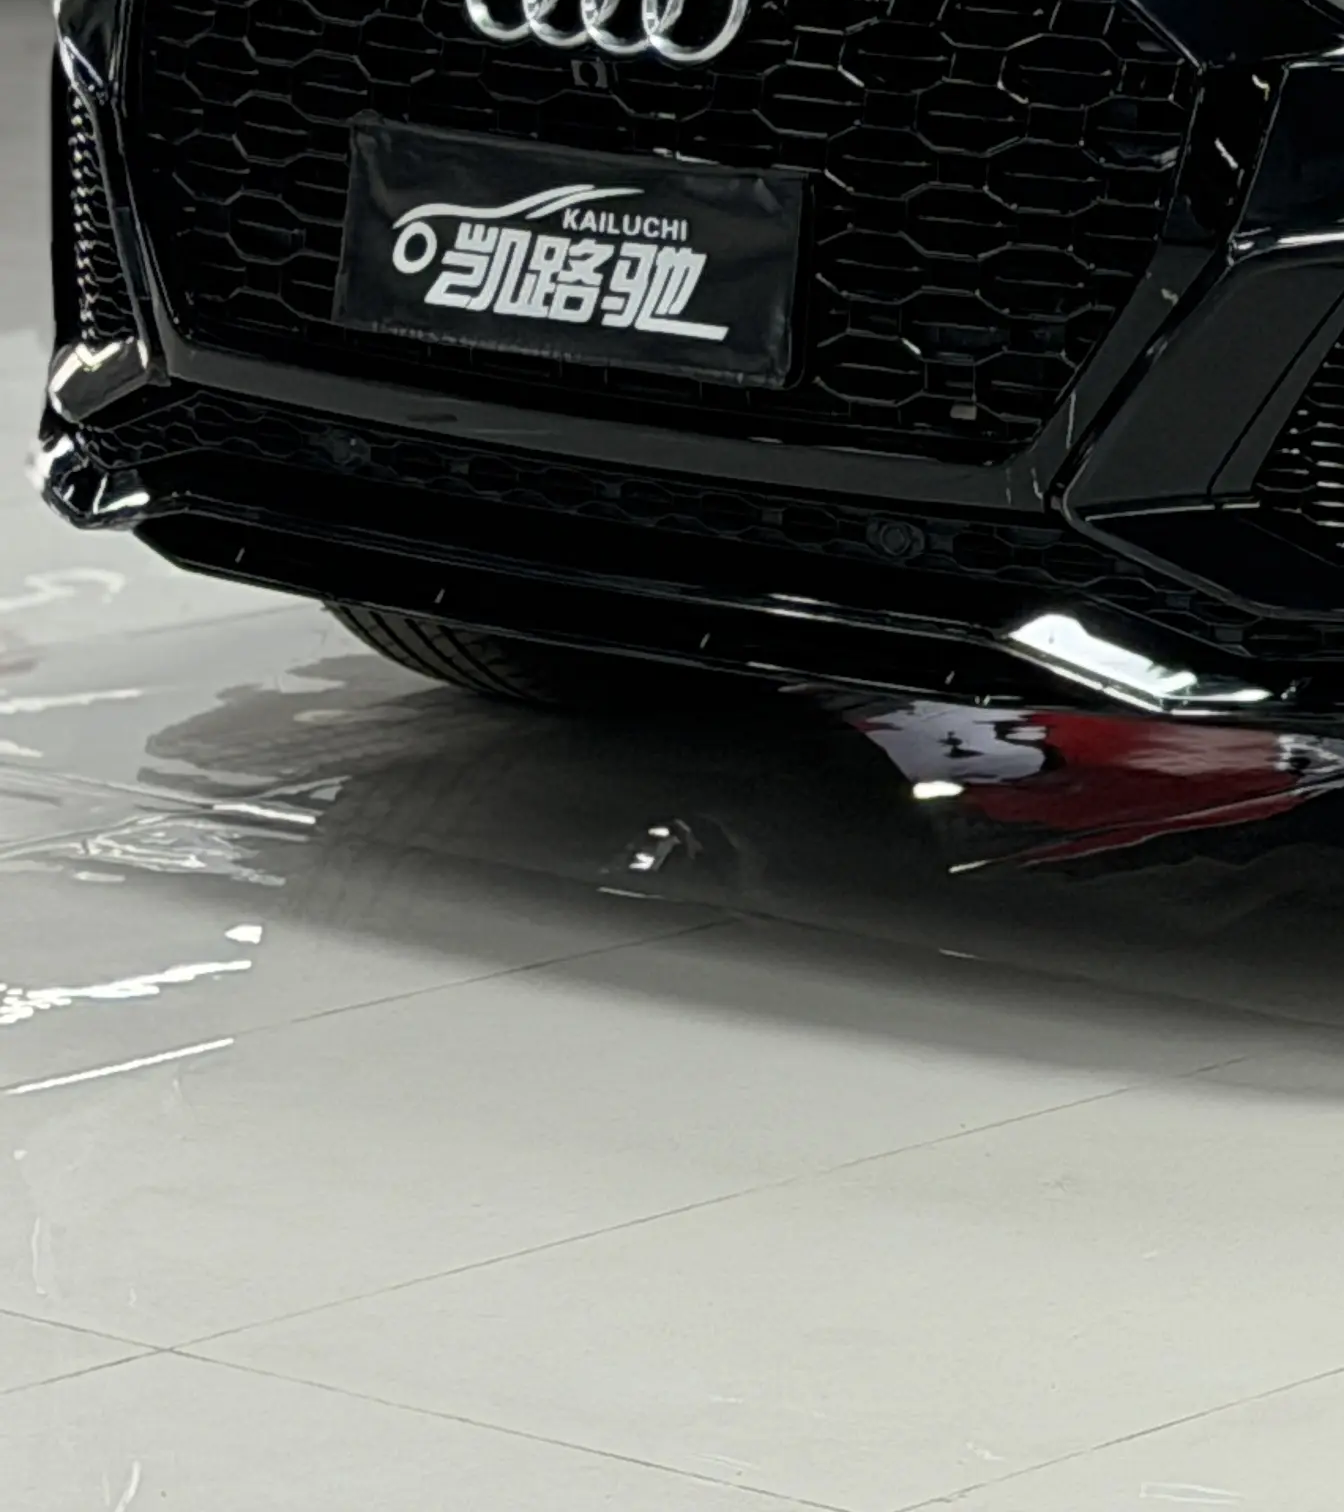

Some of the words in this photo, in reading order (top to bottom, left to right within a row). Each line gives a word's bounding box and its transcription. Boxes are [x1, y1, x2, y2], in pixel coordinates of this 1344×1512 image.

[562, 207, 688, 242] KAILUCHI
[424, 221, 729, 341] 凯路驰
